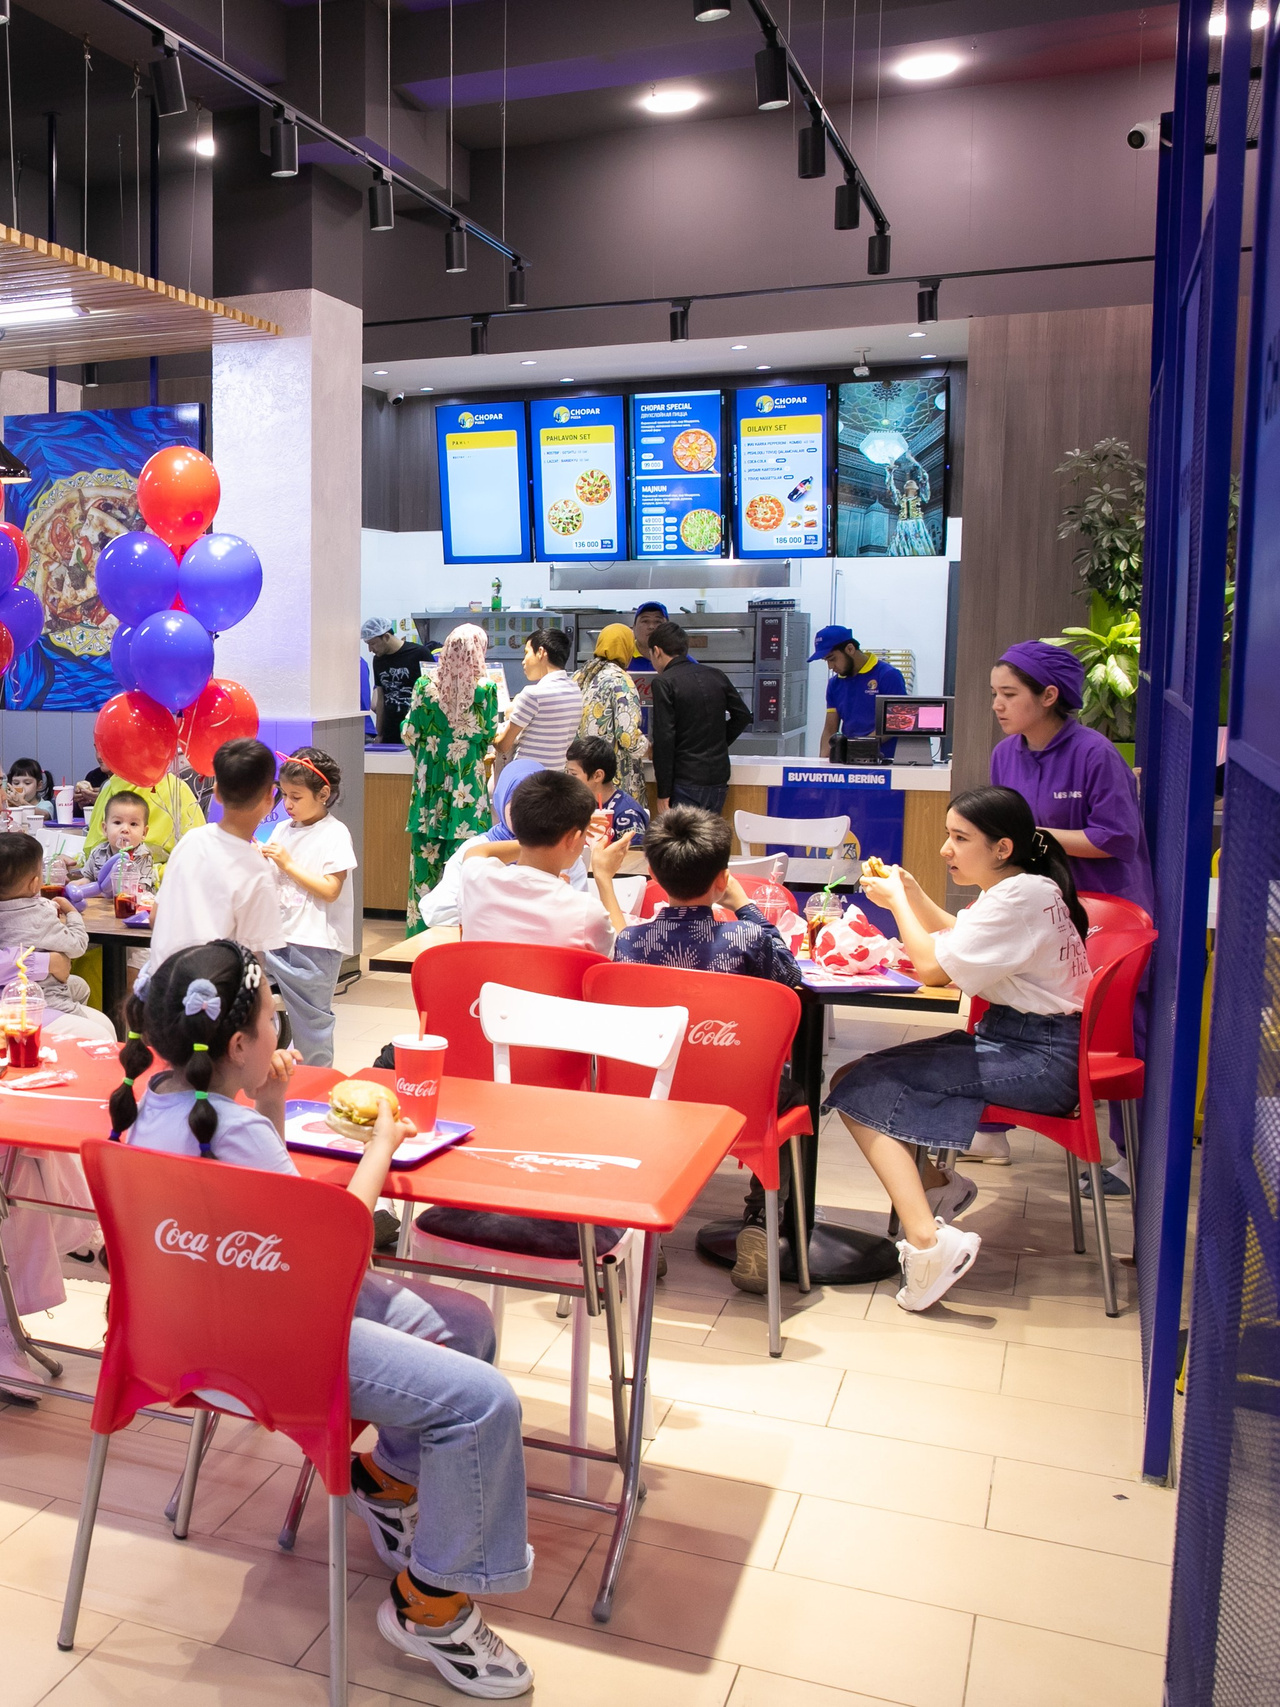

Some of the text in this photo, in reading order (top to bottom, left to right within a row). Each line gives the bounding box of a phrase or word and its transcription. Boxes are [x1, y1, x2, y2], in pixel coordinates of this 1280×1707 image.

[774, 397, 807, 405] CHOPAR
[570, 407, 600, 415] CHOPAR
[640, 403, 692, 412] CHOPAR SPECIAL
[474, 413, 503, 421] CHOPAR
[546, 434, 578, 442] PAHLAVON
[642, 485, 667, 493] MAJNUN
[788, 773, 885, 784] BUYURTMA BERING
